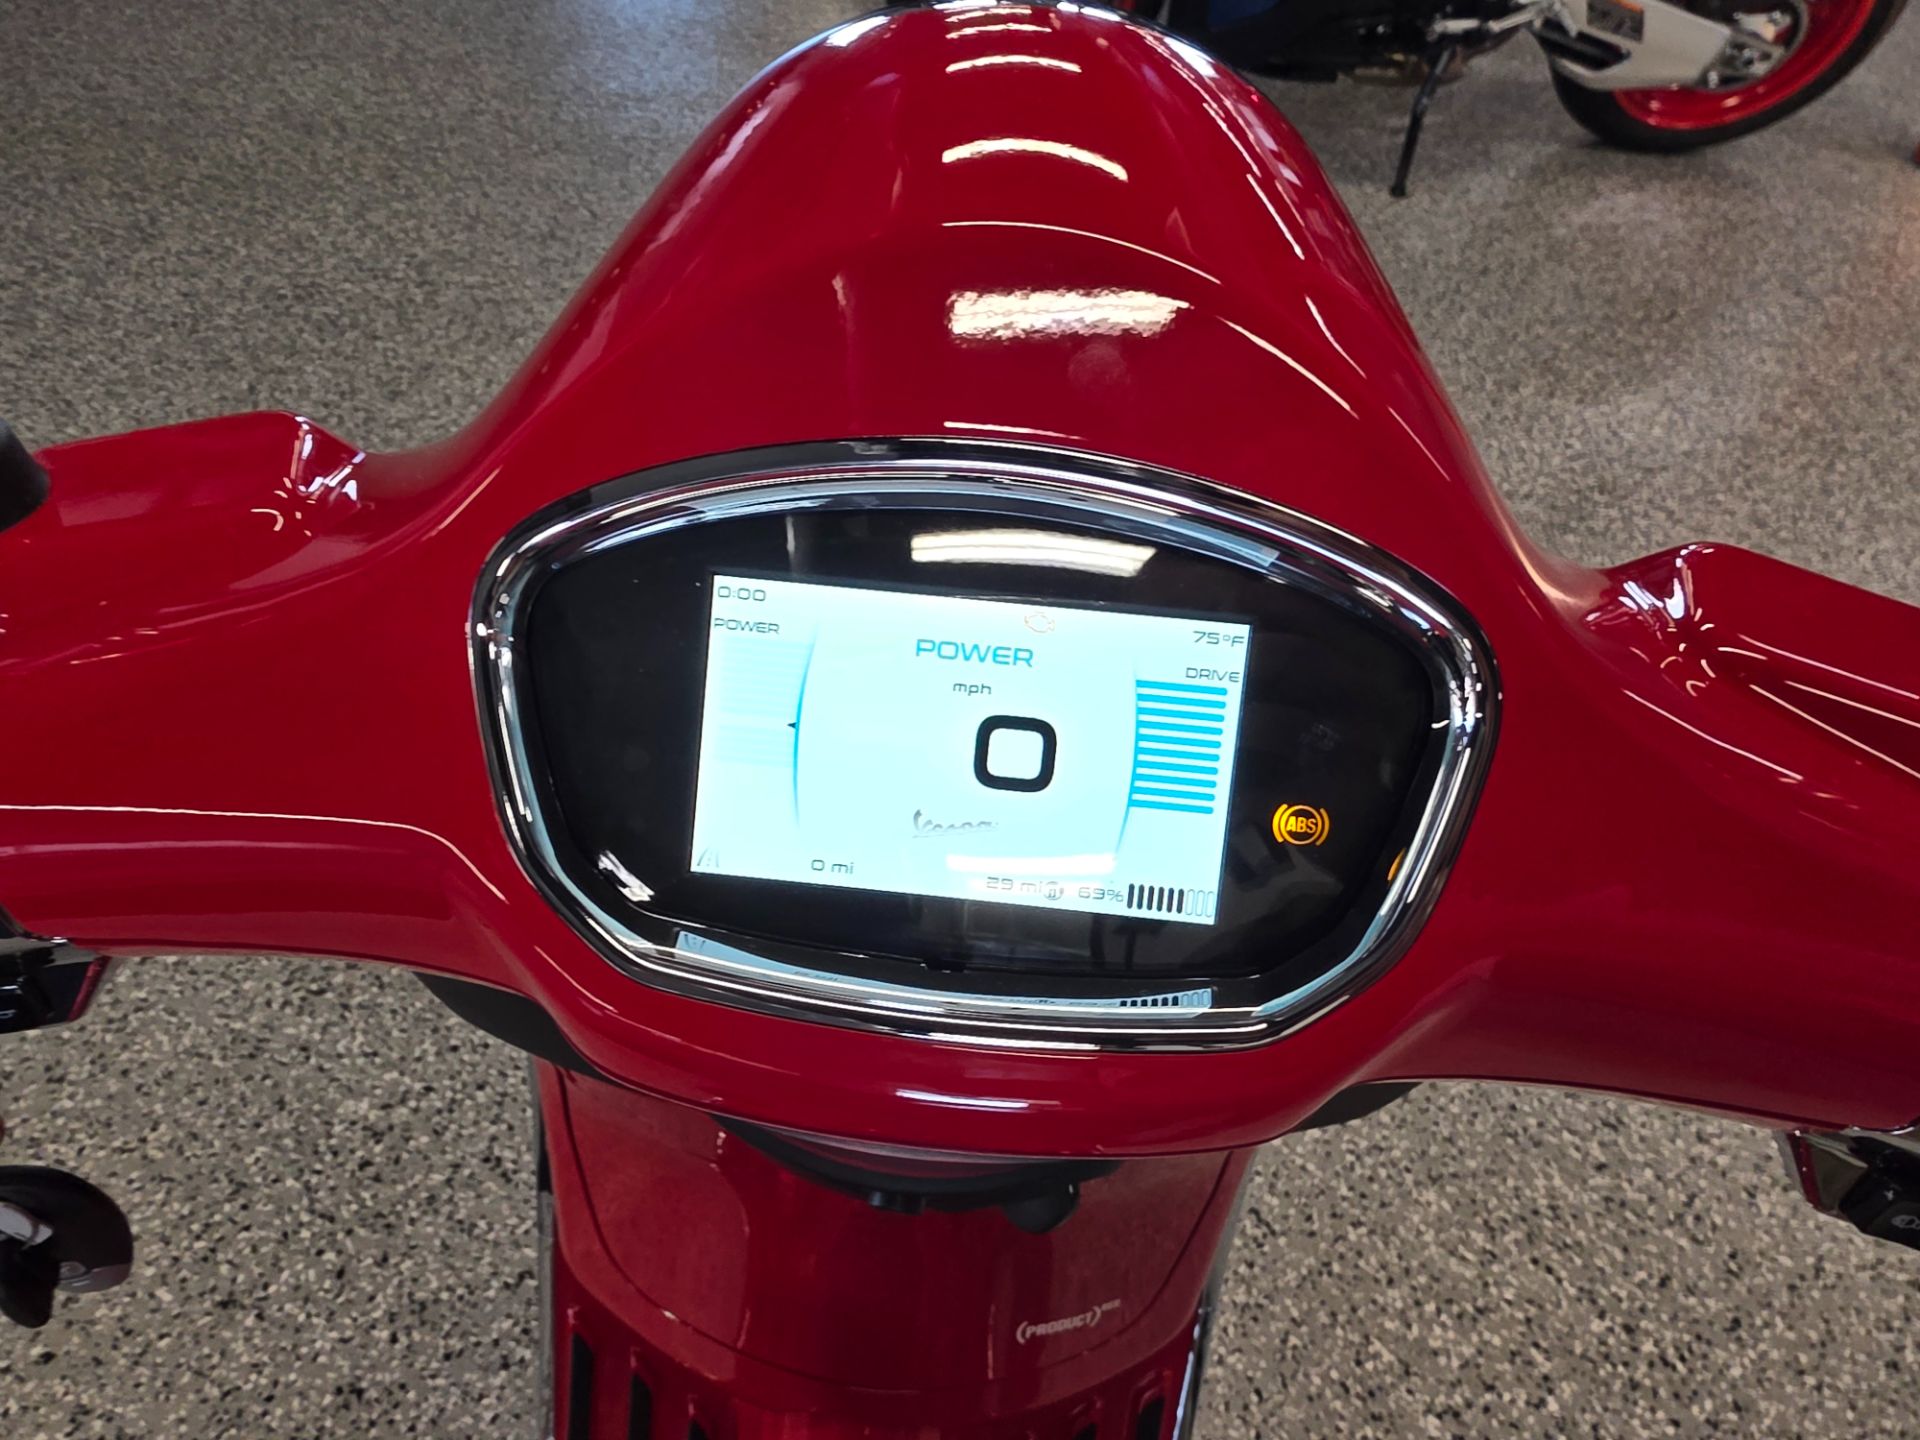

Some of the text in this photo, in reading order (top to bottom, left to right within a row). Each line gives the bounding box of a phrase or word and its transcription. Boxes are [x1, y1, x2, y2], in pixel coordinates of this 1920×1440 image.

[717, 586, 766, 602] 0:00
[714, 618, 780, 634] POWER
[1193, 631, 1245, 647] 75°F
[916, 639, 1034, 667] POWER
[1185, 667, 1240, 683] DRIVE
[953, 683, 992, 696] mph
[974, 715, 1057, 793] 0
[1286, 816, 1317, 834] ABS
[811, 859, 854, 874] 0 mi
[986, 876, 1014, 890] 29
[1020, 881, 1043, 893] mi
